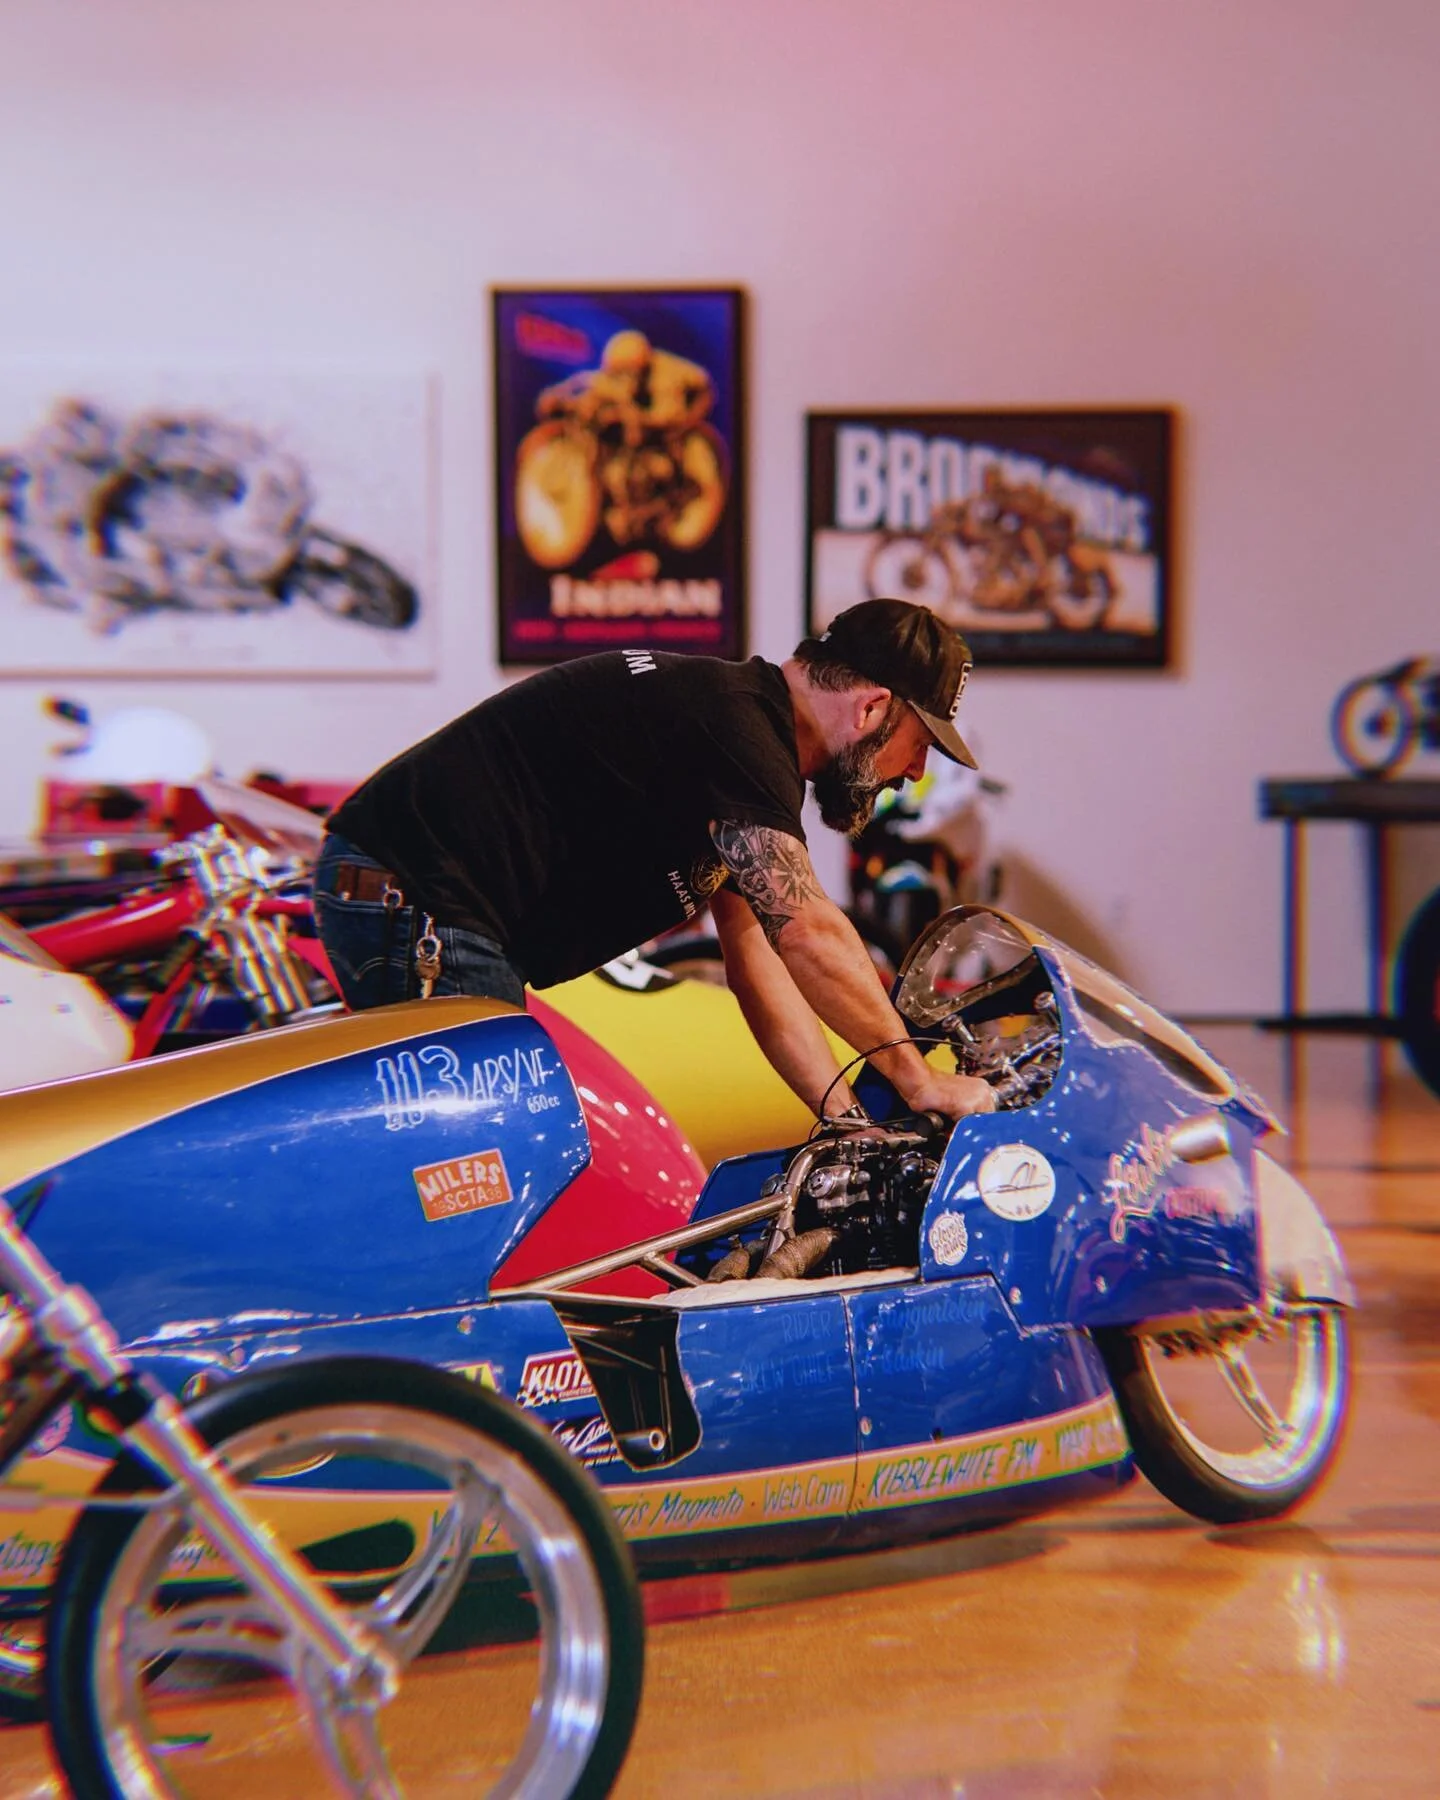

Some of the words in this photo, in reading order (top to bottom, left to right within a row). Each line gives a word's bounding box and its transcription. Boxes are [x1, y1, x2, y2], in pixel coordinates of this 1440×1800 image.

[667, 870, 691, 904] HAAS
[527, 1095, 560, 1114] 650cc
[417, 1160, 501, 1203] MILERS
[781, 1310, 831, 1344] RIDER
[650, 1487, 744, 1529] Magneto
[867, 1443, 1006, 1502] KIBBLEWHITE
